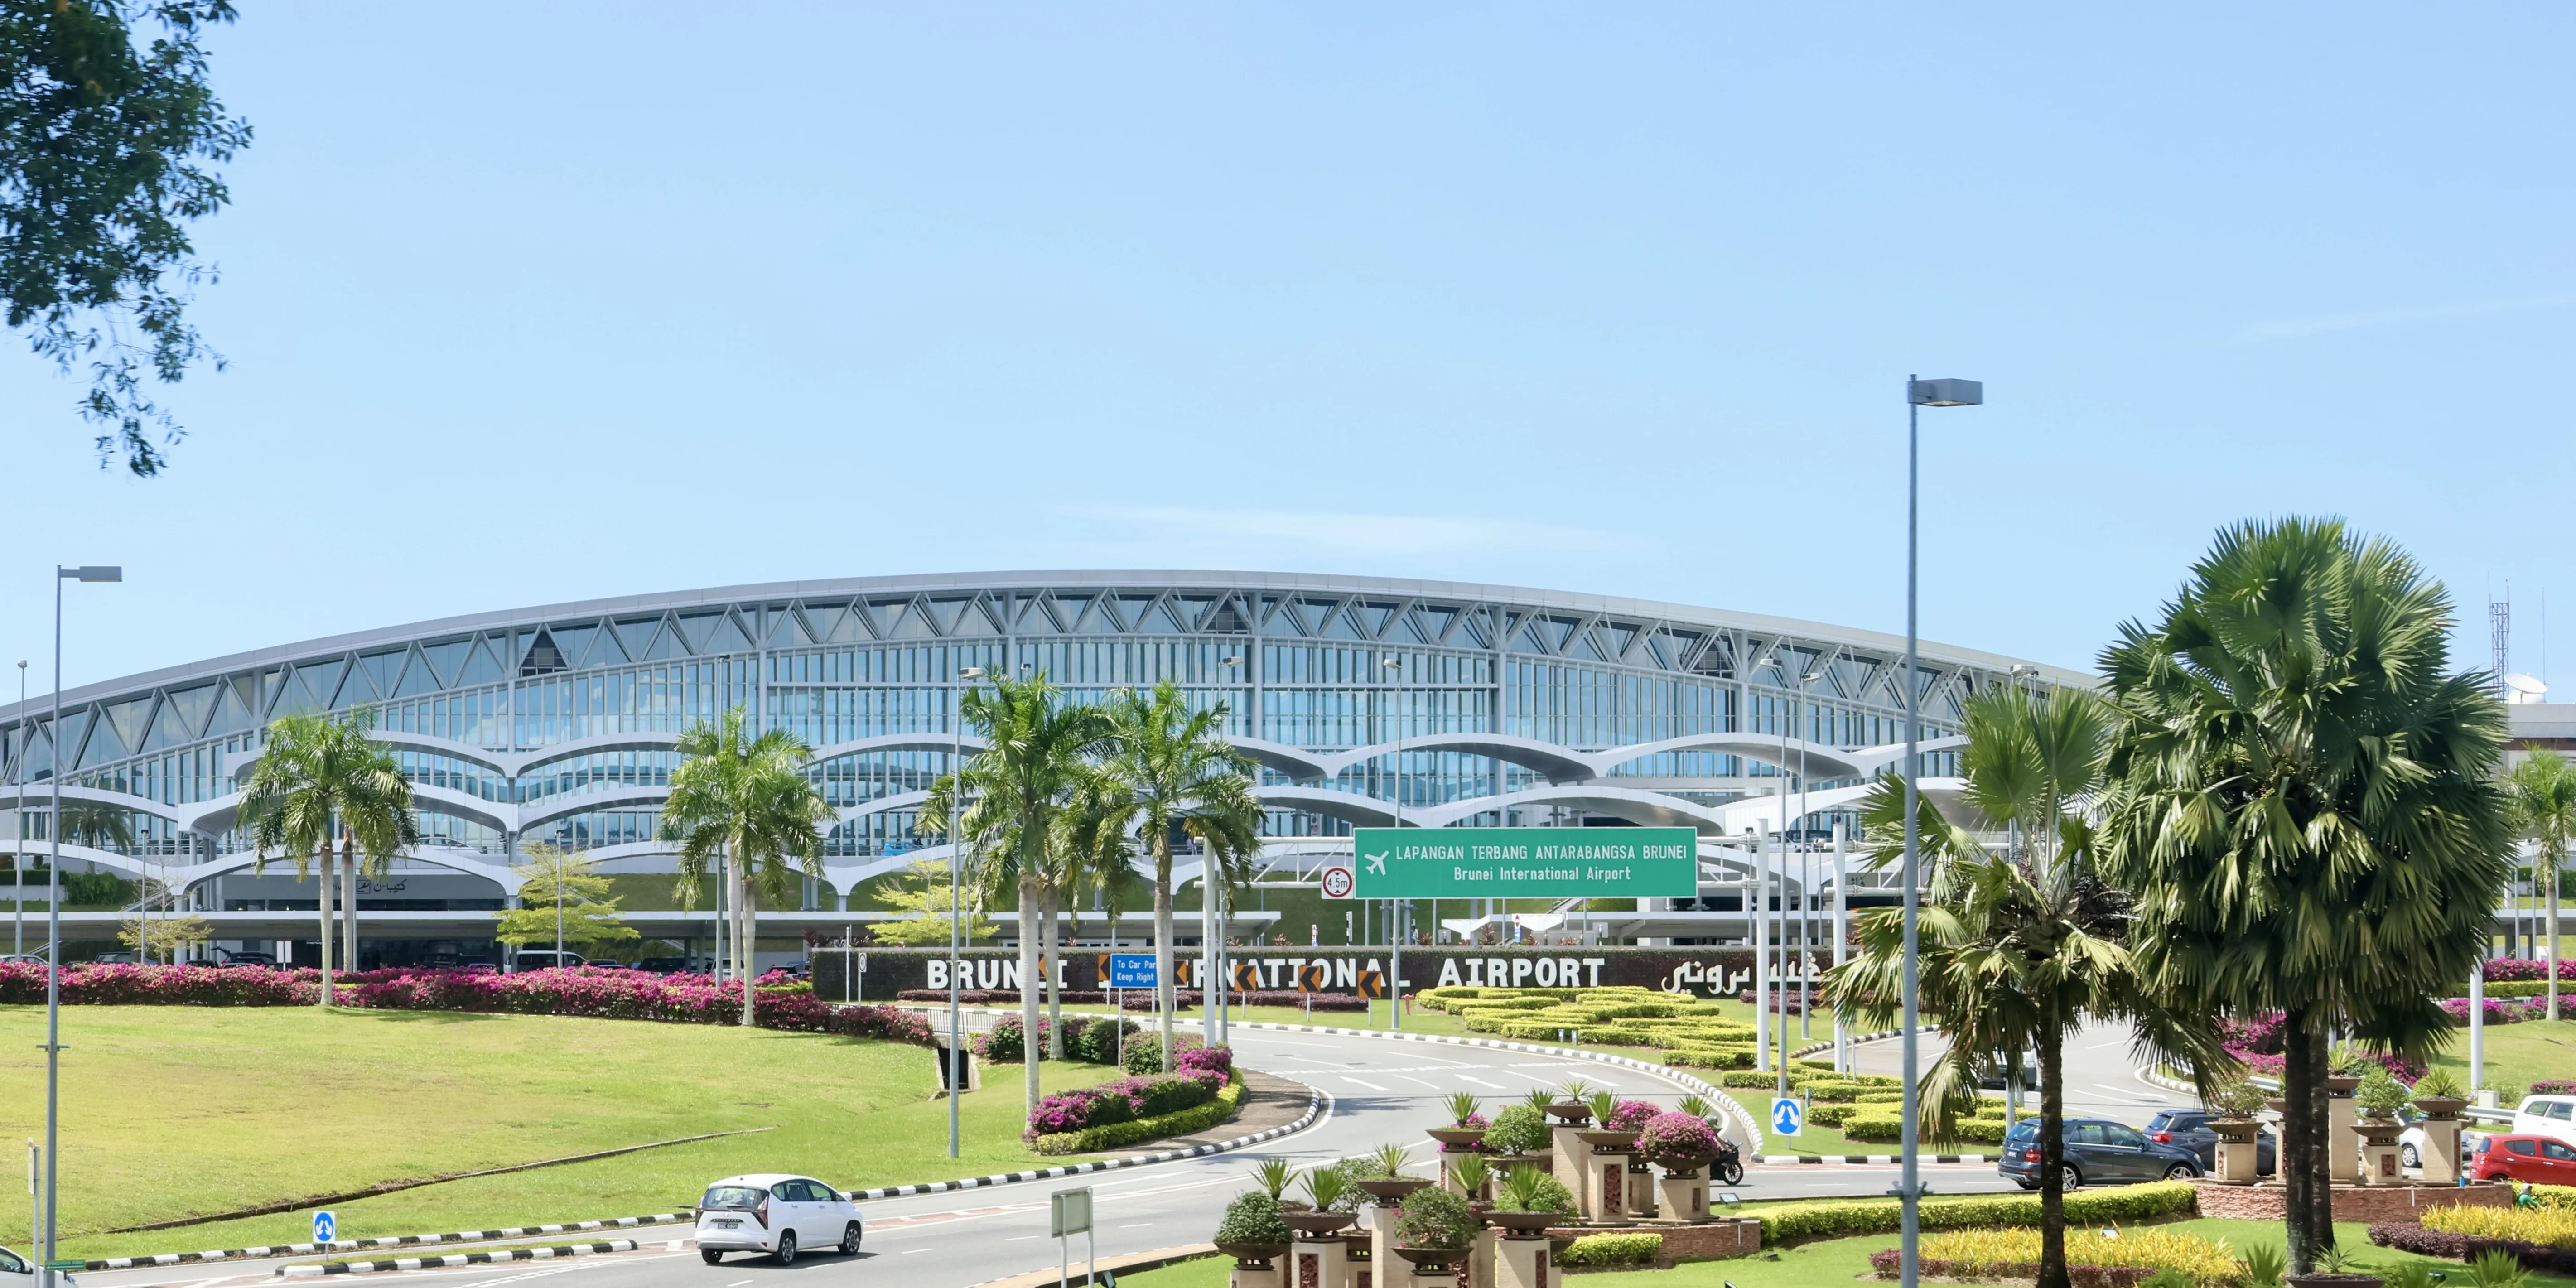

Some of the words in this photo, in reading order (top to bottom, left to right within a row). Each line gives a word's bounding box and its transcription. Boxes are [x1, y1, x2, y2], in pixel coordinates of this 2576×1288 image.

[1396, 846, 1464, 860] LAPANGAN
[1471, 846, 1528, 859] TERBANG
[1535, 845, 1635, 859] ANTARABANGSA
[1643, 845, 1687, 859] BRUNEI
[1454, 866, 1493, 880] Brunei
[1500, 866, 1579, 880] International
[1587, 866, 1631, 883] Airport
[1327, 878, 1348, 888] 4.5m
[1117, 960, 1125, 969] To
[1129, 960, 1141, 969] Car
[1145, 960, 1156, 969] Par
[927, 959, 1067, 989] BRUNI
[1438, 957, 1605, 987] AIRPORT
[1117, 972, 1133, 982] Keep
[1137, 973, 1154, 983] Right
